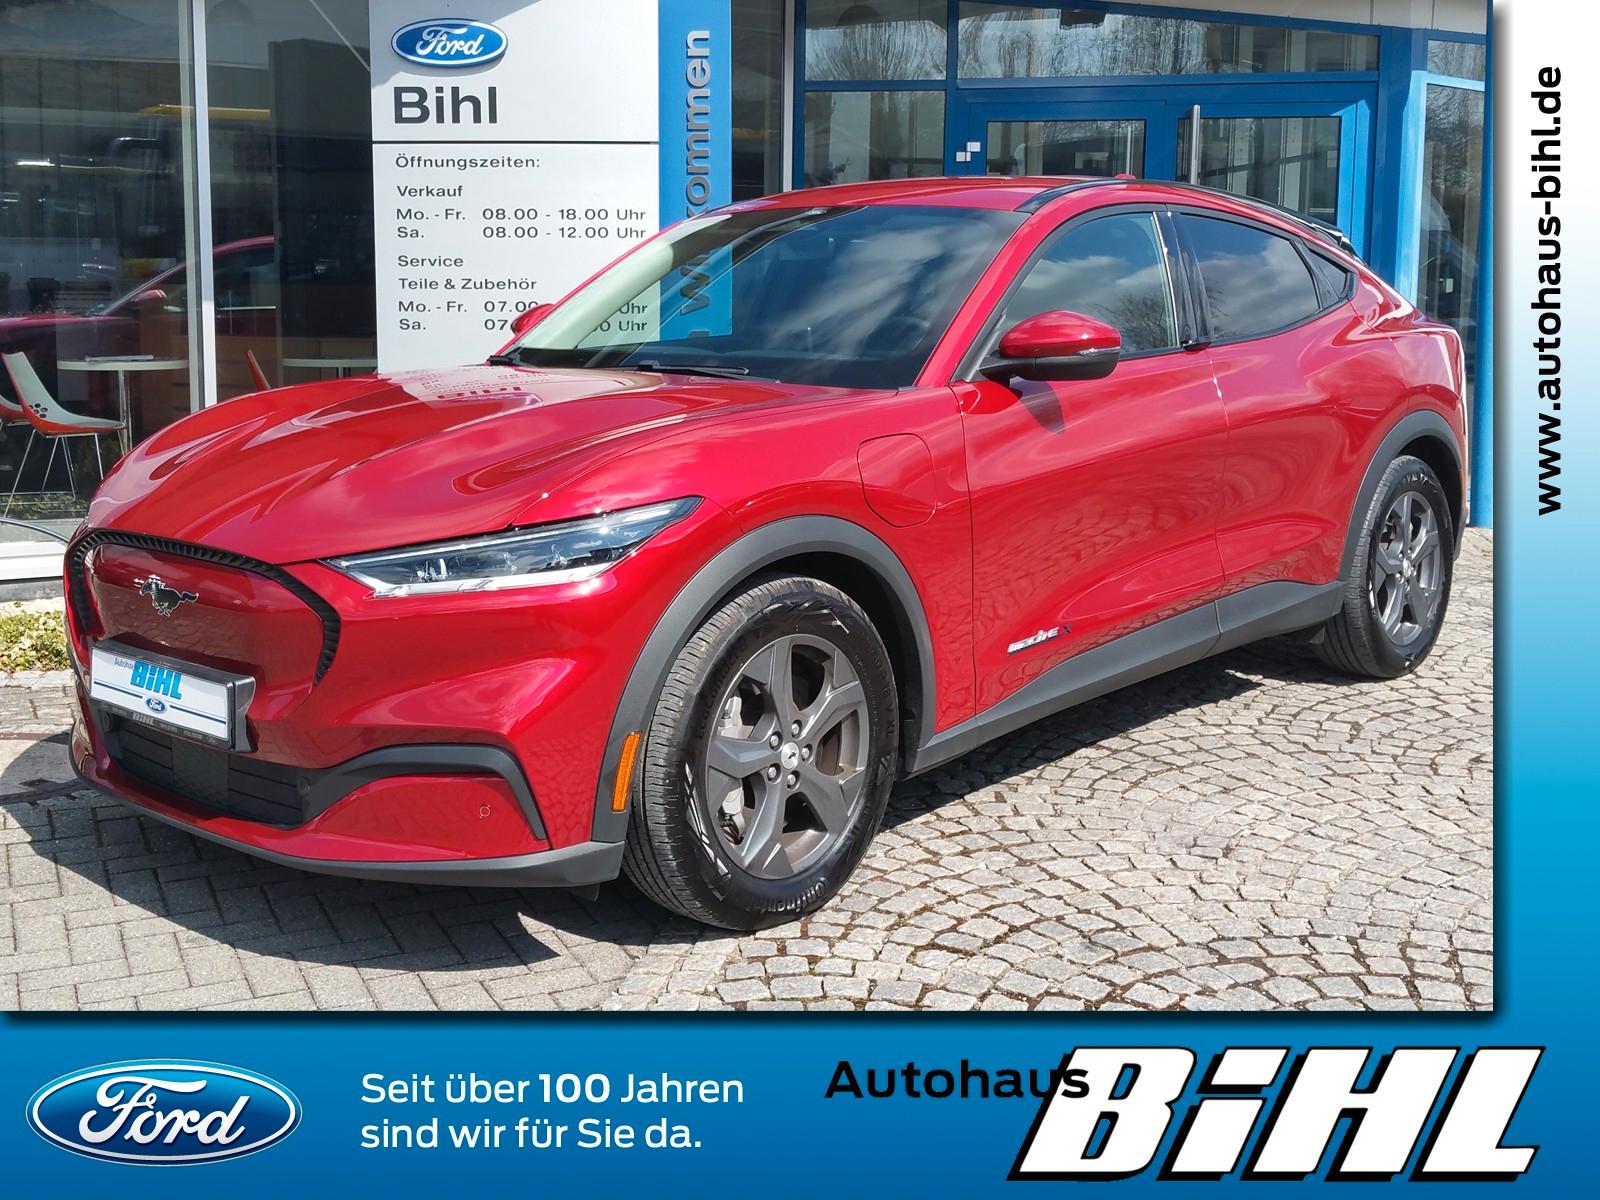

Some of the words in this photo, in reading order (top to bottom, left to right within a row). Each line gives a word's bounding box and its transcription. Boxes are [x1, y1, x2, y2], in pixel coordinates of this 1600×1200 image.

[416, 26, 486, 57] Ford
[393, 86, 498, 124] Bihl
[395, 153, 540, 171] Öffnungszeiten:
[396, 185, 463, 198] Verkauf
[396, 208, 430, 221] Mo.
[444, 208, 466, 221] Fr.
[482, 208, 538, 221] 08.00
[557, 208, 609, 221] 18.00
[616, 209, 646, 221] Uhr
[397, 226, 425, 239] Sa.
[482, 226, 538, 239] 08.00
[558, 226, 609, 239] 12.00
[617, 226, 646, 239] Uhr
[397, 255, 464, 268] Service
[398, 278, 439, 290] Teile
[444, 278, 456, 290] &
[461, 278, 537, 290] Zubehör
[398, 300, 432, 313] Mo.
[446, 300, 467, 313] Fr.
[399, 318, 426, 331] Sa.
[618, 320, 648, 332] Uhr
